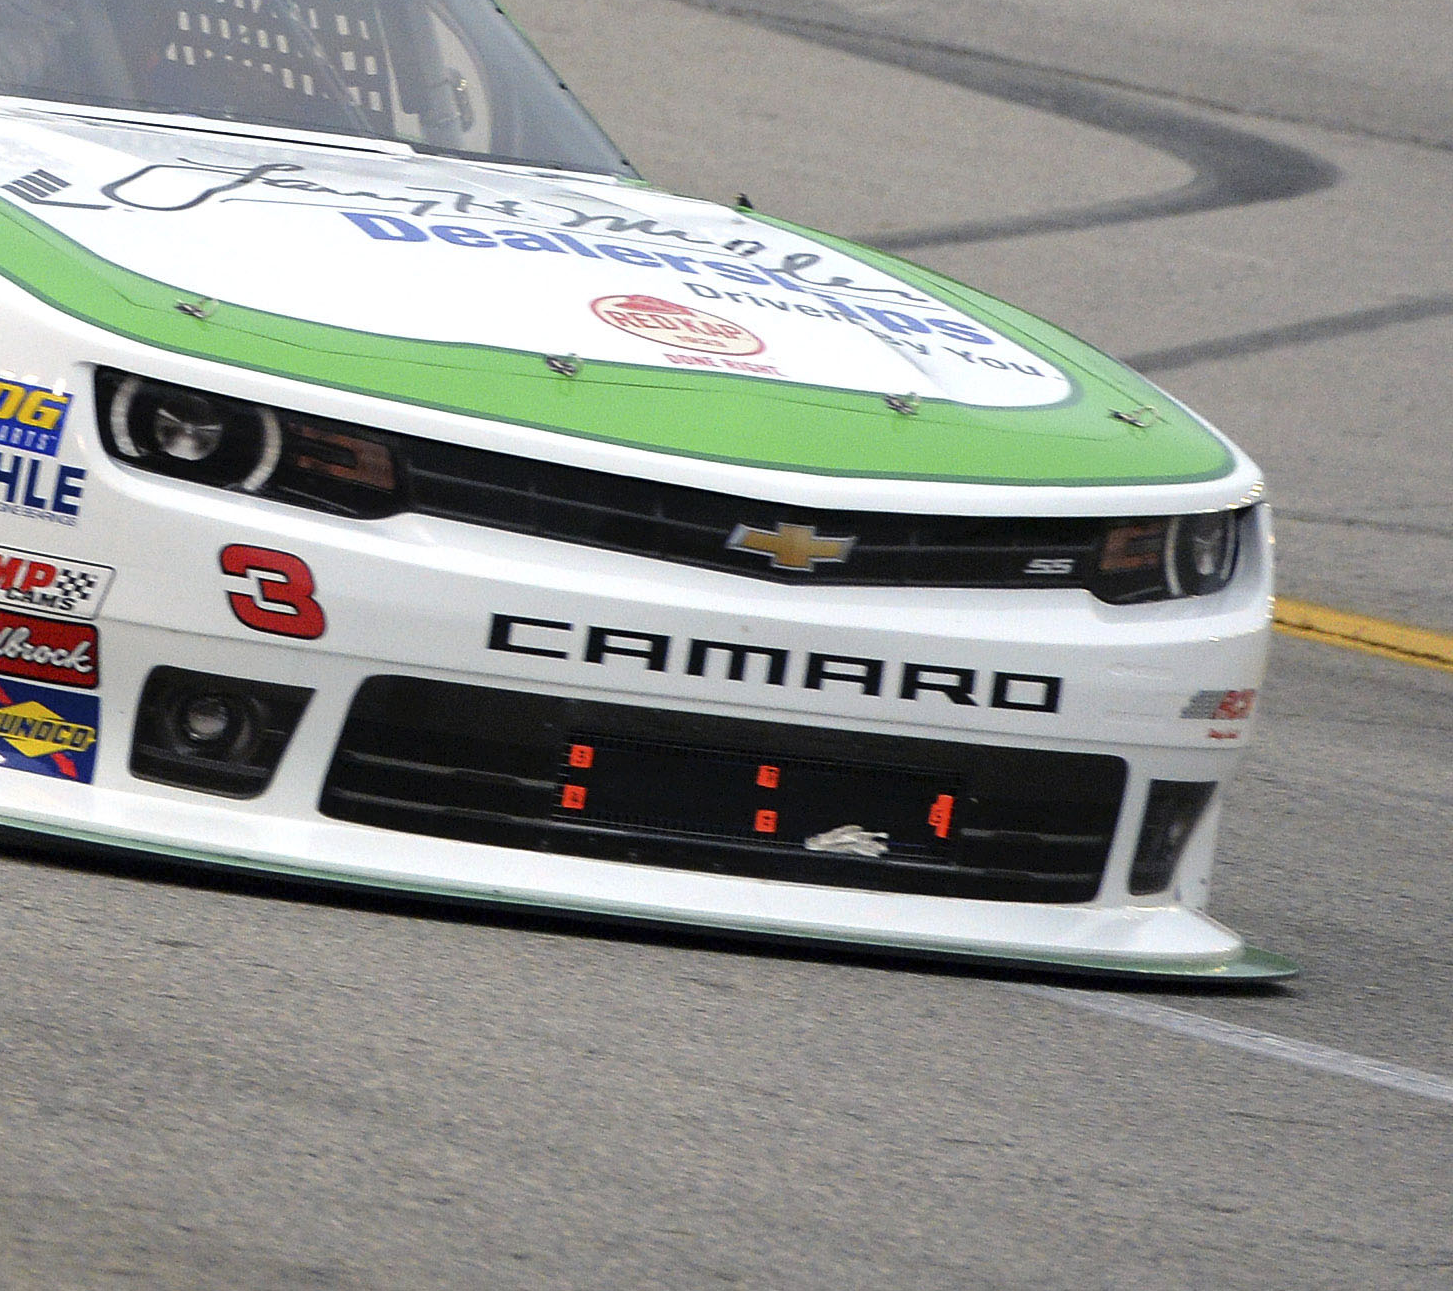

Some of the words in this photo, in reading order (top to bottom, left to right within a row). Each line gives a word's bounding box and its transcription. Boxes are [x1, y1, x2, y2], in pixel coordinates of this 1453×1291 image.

[604, 310, 679, 330] RED
[676, 317, 743, 340] KAP
[4, 587, 78, 611] CAMS
[220, 543, 326, 641] 3
[488, 612, 1064, 714] CAMARO
